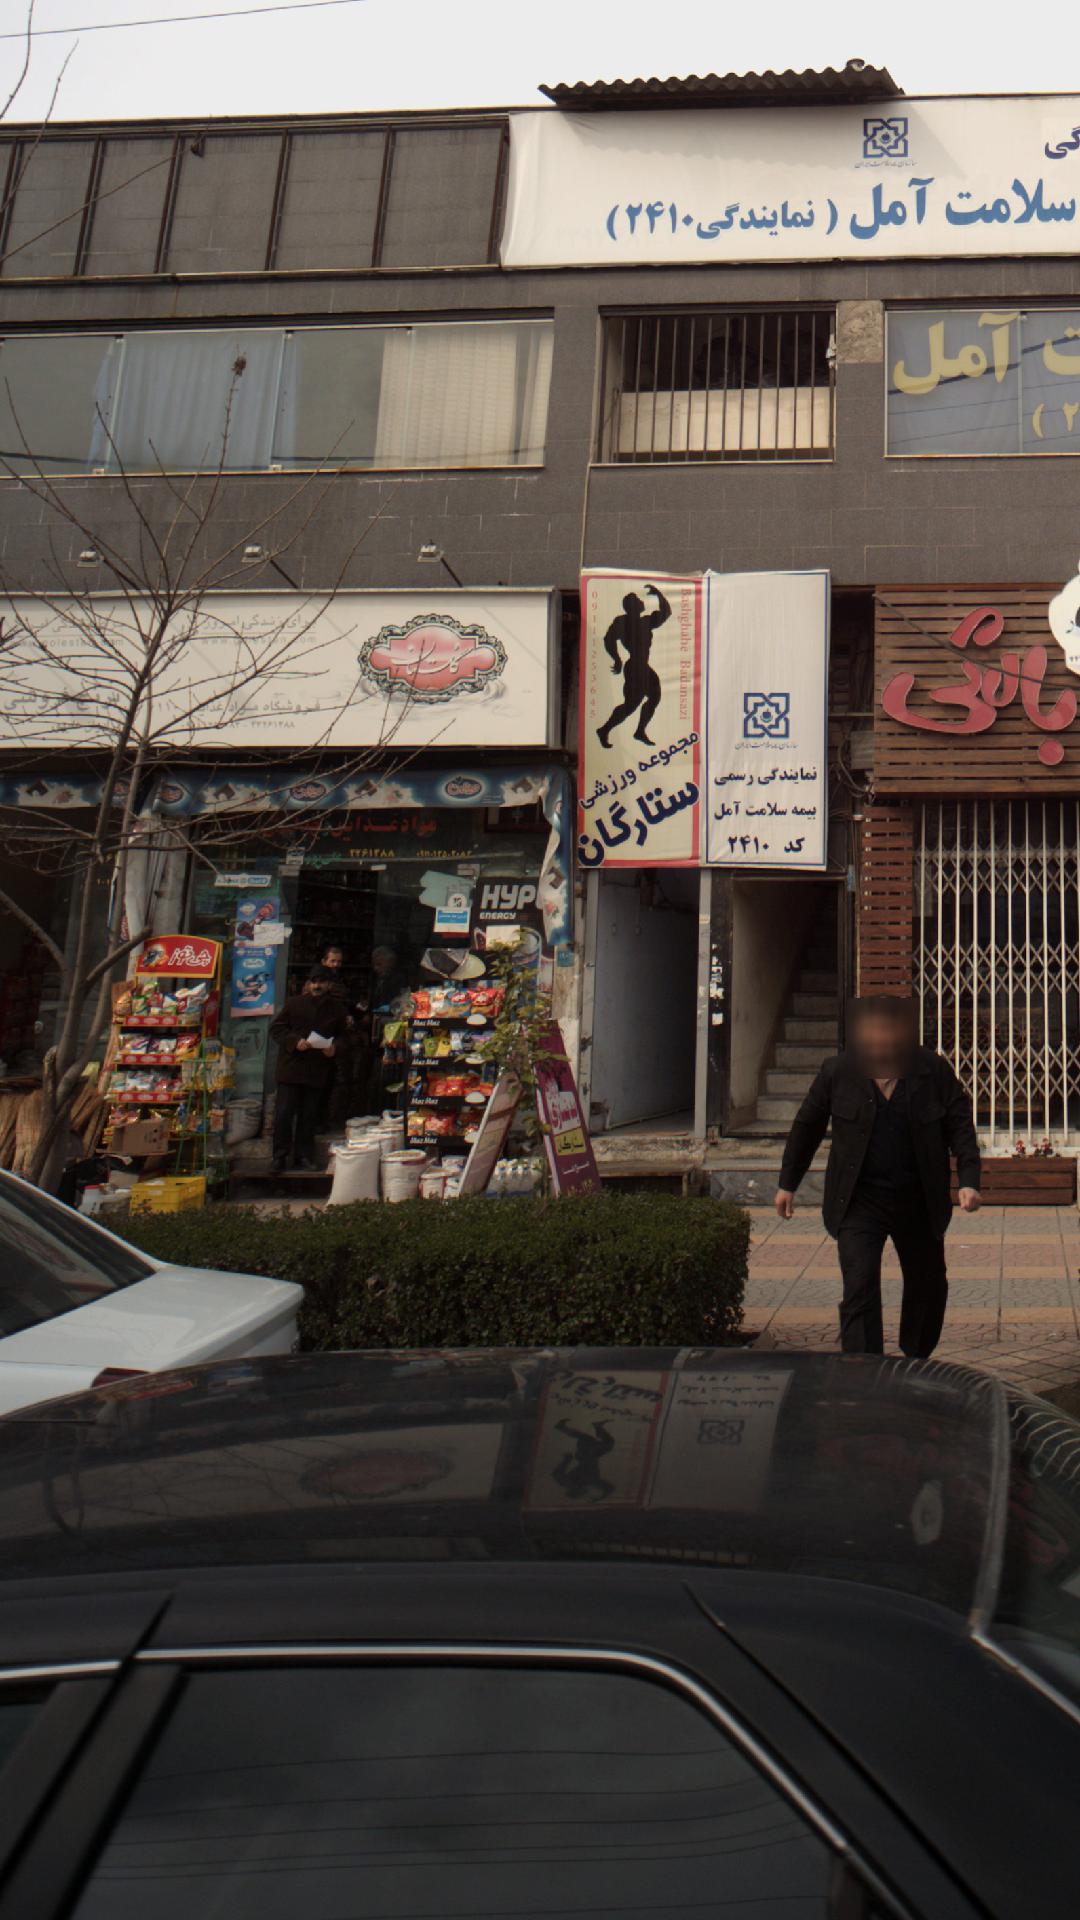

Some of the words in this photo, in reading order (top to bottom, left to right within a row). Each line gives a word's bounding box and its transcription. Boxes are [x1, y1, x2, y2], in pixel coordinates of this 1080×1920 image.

[850, 177, 934, 240] آمل
[946, 178, 1076, 226] سلامت
[892, 311, 1021, 395] آمل
[678, 660, 692, 720] Badansazi
[638, 731, 699, 773] مجموعه
[579, 768, 638, 810] ورزشی
[713, 772, 754, 787] رسمی
[757, 766, 818, 787] نمایندگی
[577, 781, 700, 867] ستارگان
[713, 799, 741, 821] آمل
[745, 801, 788, 817] سلامت
[791, 805, 817, 820] بیمه
[727, 834, 770, 855] ۲۴۱۰
[783, 836, 806, 855] کد
